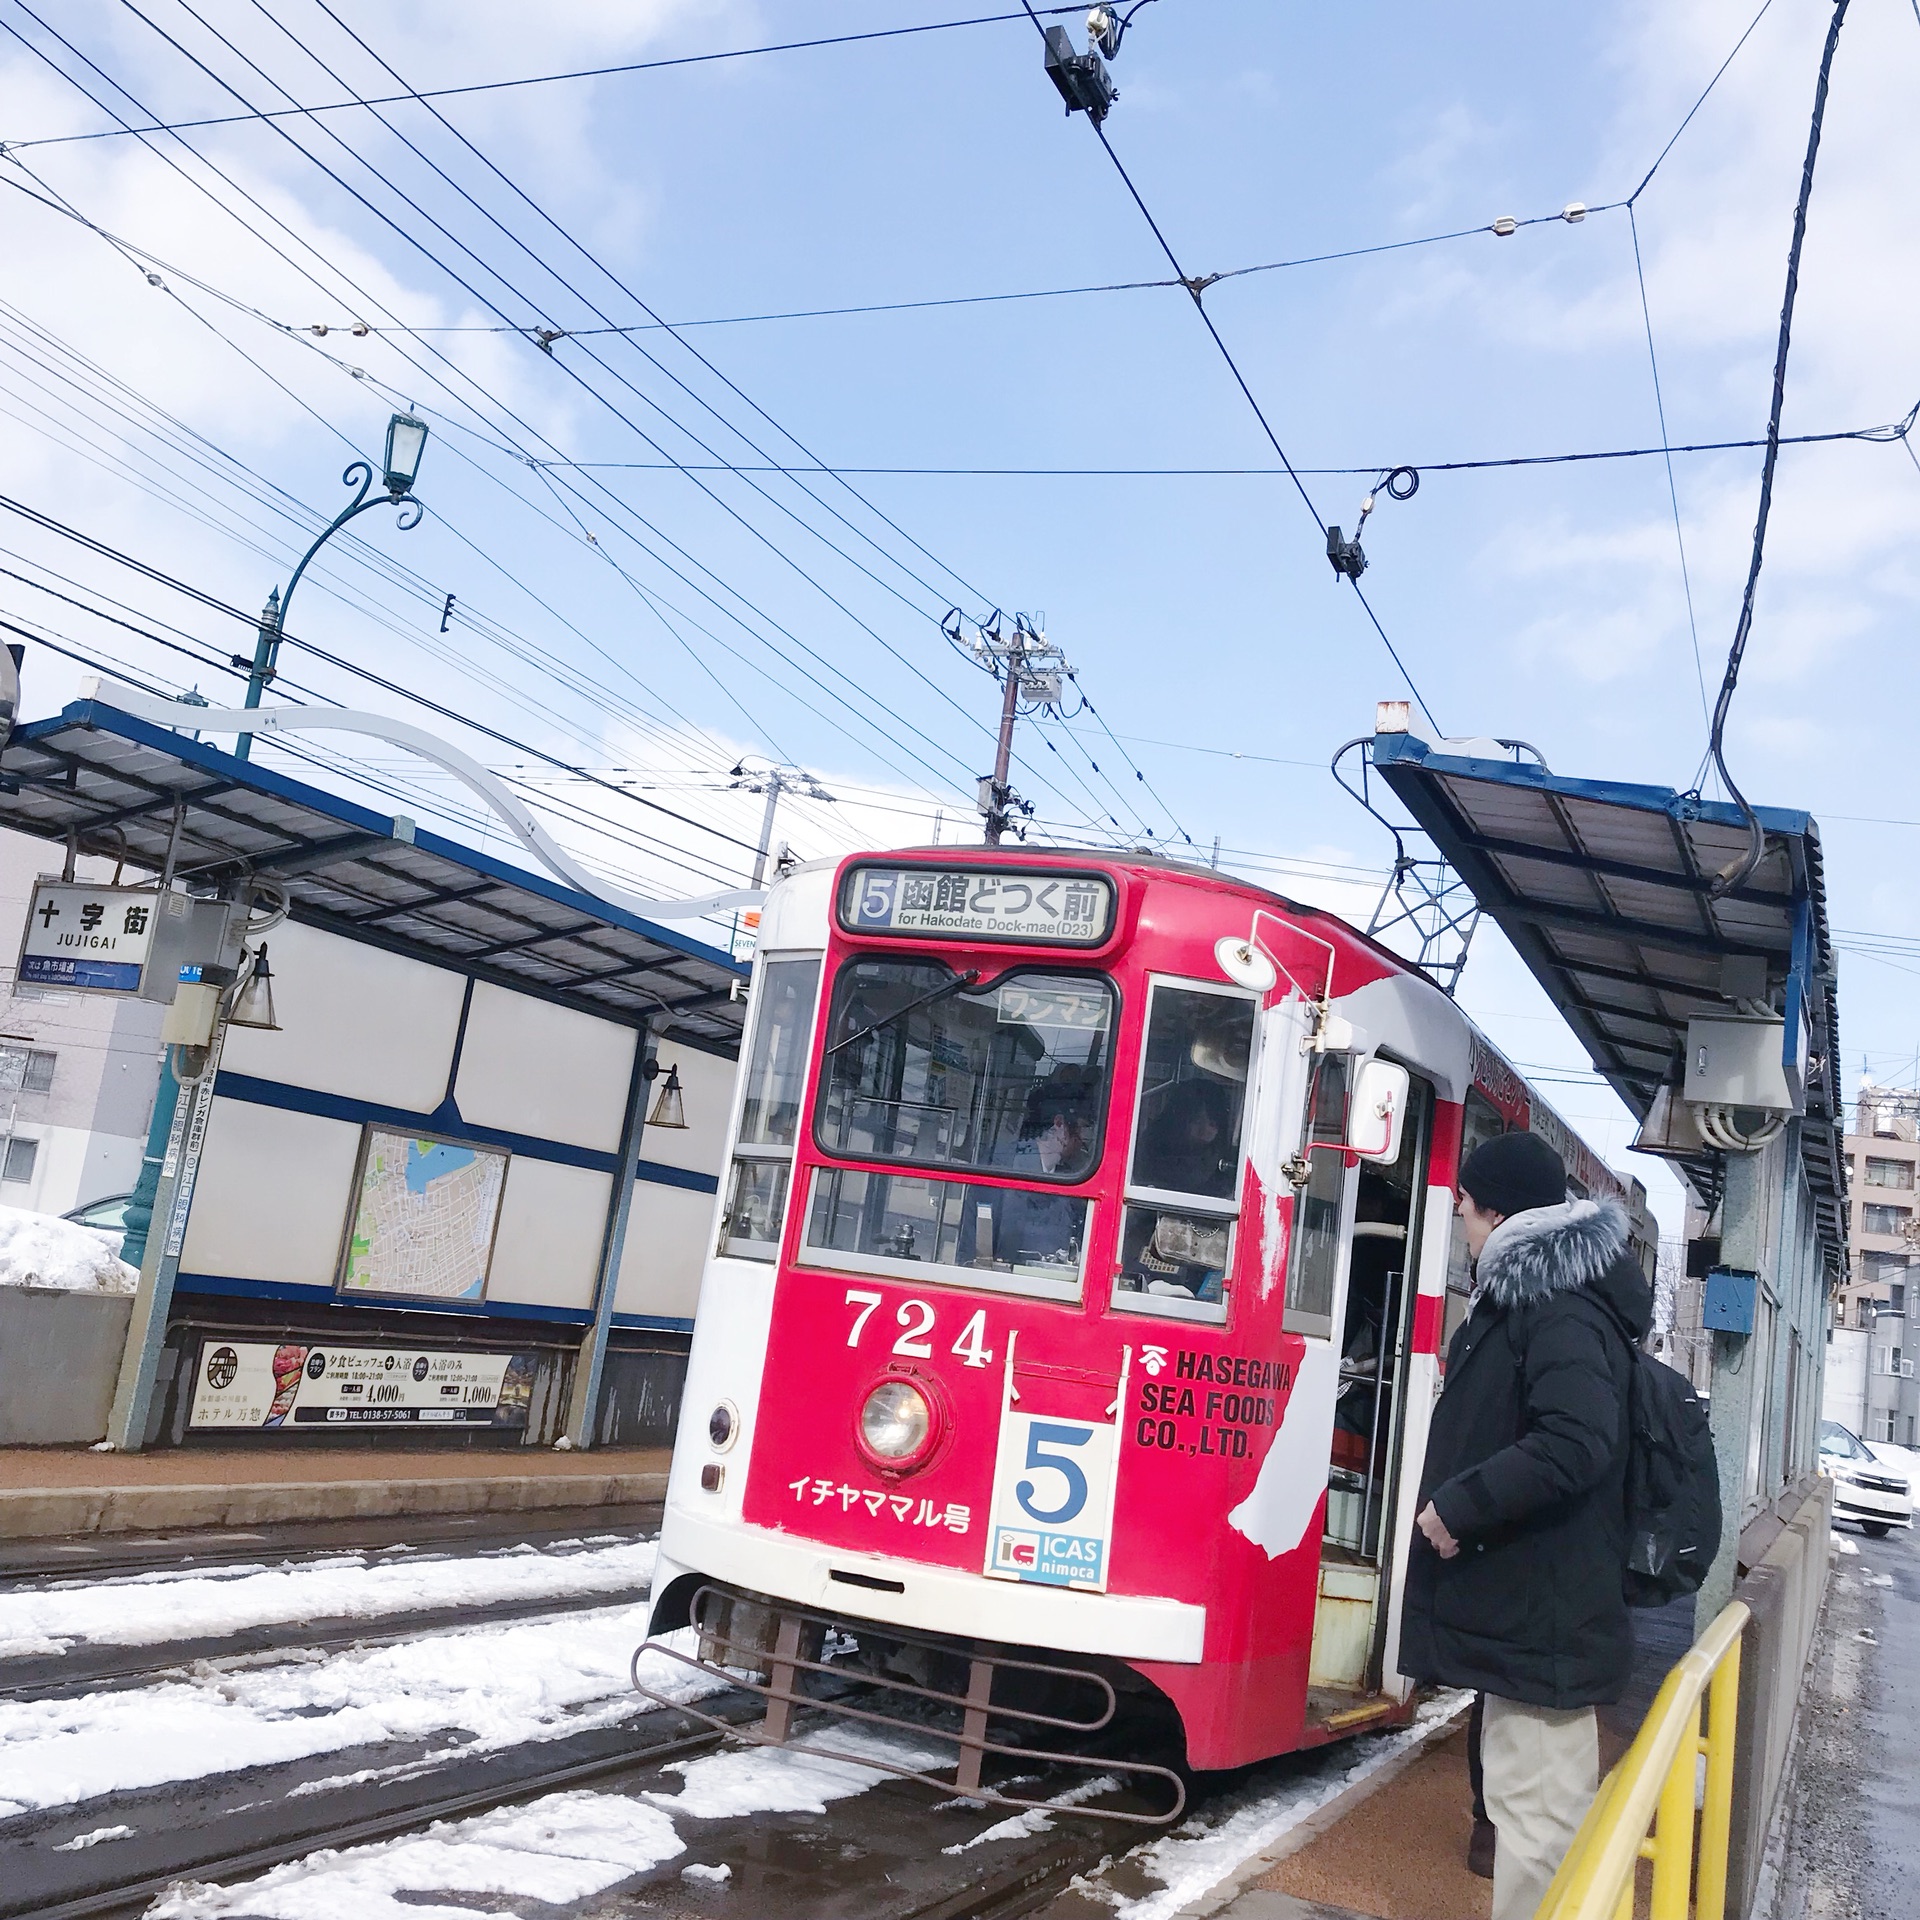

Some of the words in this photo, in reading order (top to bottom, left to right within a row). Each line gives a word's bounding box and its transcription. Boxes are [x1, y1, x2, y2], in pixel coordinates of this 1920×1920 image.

[862, 879, 893, 918] 5
[38, 900, 149, 935] 十字街
[898, 912, 917, 925] for
[920, 913, 983, 929] Hakodate
[986, 918, 1094, 938] Dock-mae(D23)
[57, 933, 117, 950] JUJIGAI
[1004, 992, 1105, 1025] ワンマン
[845, 1289, 993, 1369] 724
[1176, 1350, 1291, 1391] HASEGAWA
[1140, 1383, 1195, 1417] SEA
[1205, 1391, 1275, 1426] FOODS
[1015, 1421, 1094, 1524] 5
[788, 1476, 971, 1534] イチヤママル号
[1043, 1536, 1097, 1562] ICAS
[1041, 1560, 1095, 1579] nimoca
